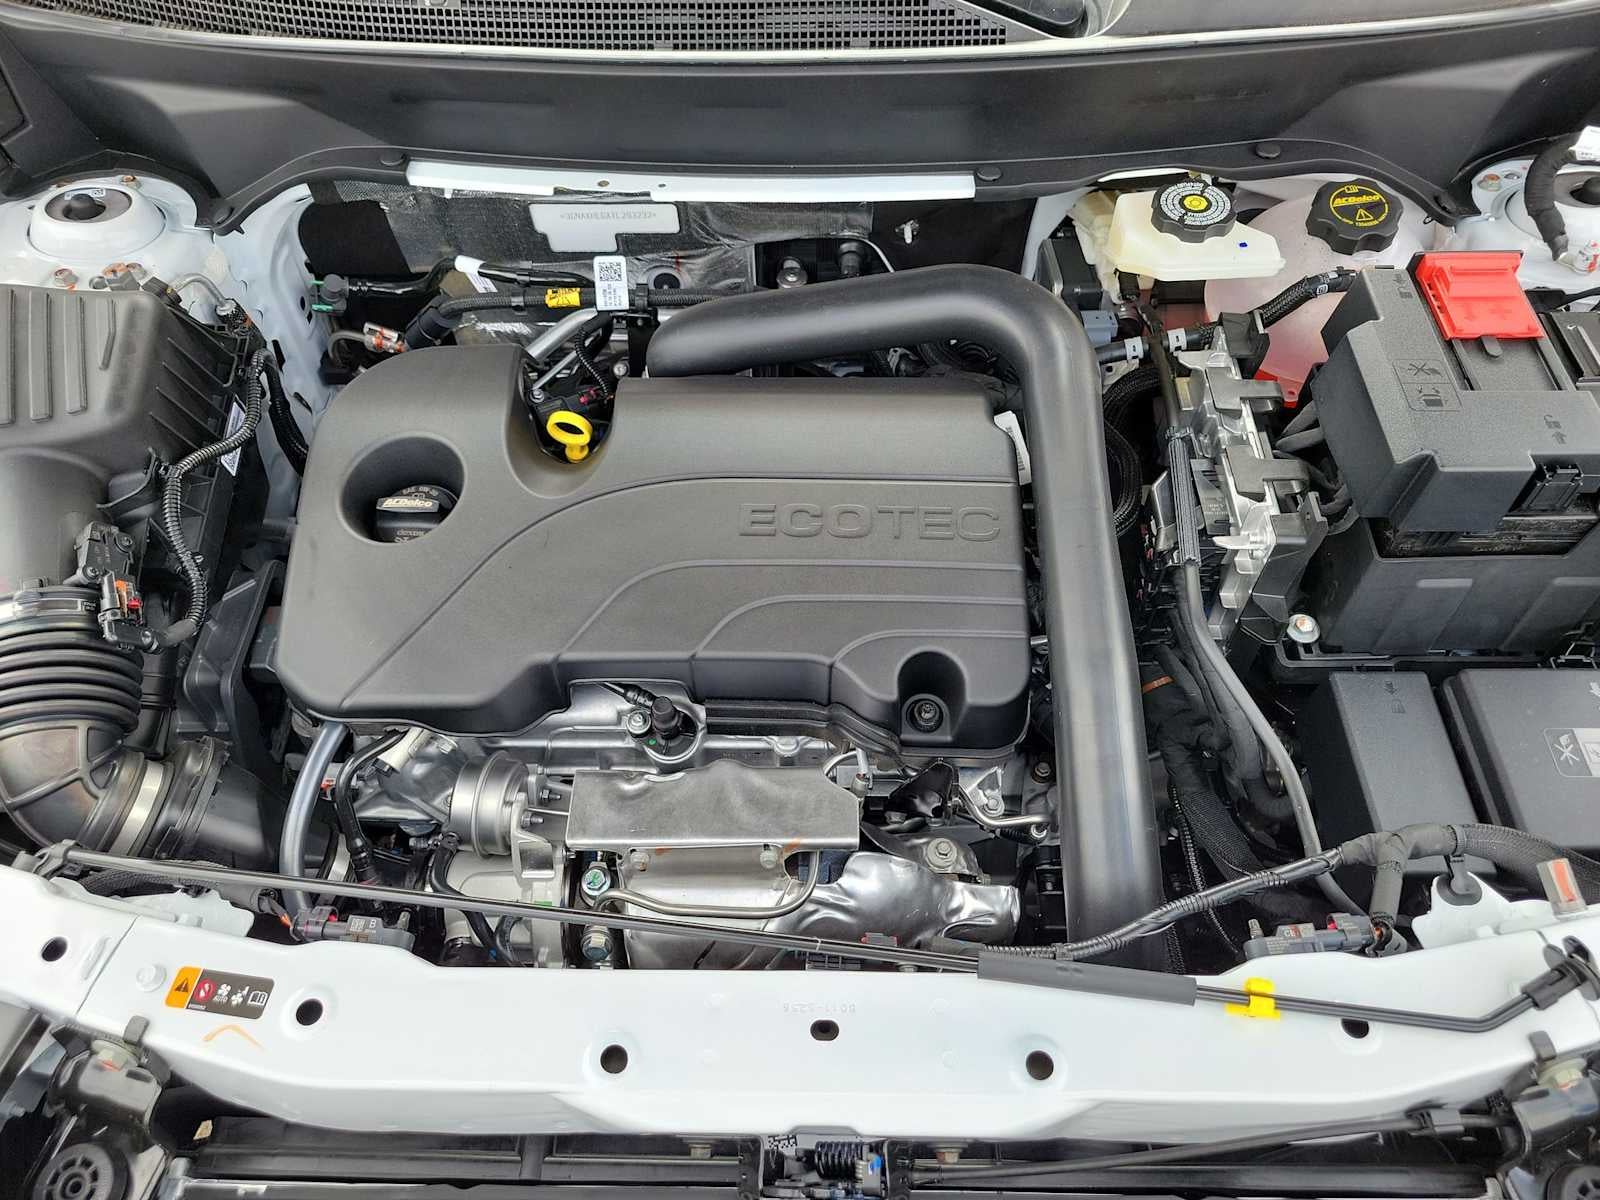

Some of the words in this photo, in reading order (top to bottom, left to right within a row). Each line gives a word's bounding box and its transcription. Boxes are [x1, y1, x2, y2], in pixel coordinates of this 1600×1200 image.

[1333, 195, 1380, 206] ACDelco
[383, 498, 433, 508] ACDelco
[739, 503, 1000, 541] ECOTEC
